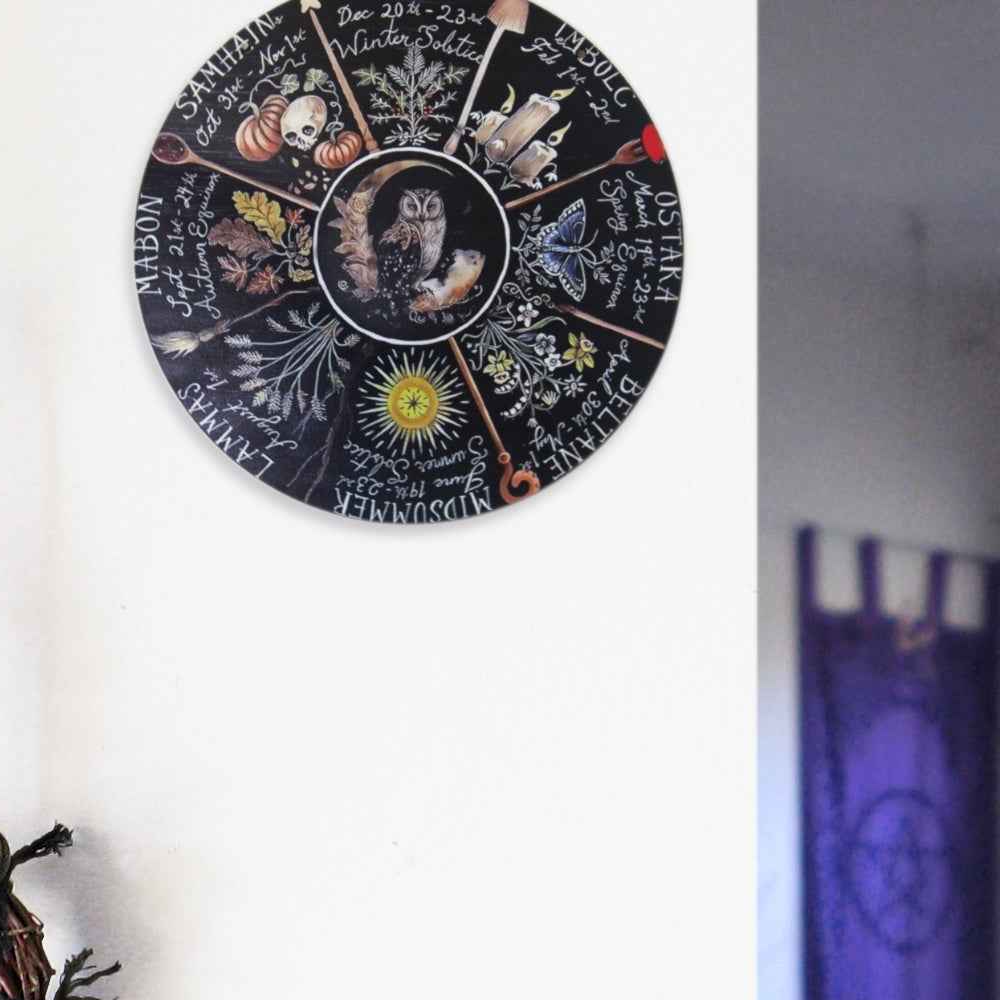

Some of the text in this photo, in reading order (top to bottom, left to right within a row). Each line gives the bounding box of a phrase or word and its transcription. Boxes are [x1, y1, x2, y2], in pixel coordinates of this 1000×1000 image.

[327, 17, 484, 65] Winter Solstice
[337, 4, 374, 27] Dec
[175, 12, 276, 120] SAMHAIN
[520, 37, 562, 65] Feb
[555, 23, 632, 108] IMBOLC
[196, 105, 222, 147] Oct
[259, 43, 286, 74] Nov
[625, 170, 656, 229] March
[134, 193, 164, 295] MABON
[187, 172, 222, 320] Autumn Equinox
[597, 178, 638, 309] Spring Equinox
[654, 191, 683, 303] OSTARA
[162, 266, 195, 318] Sept
[597, 338, 631, 396] April
[178, 382, 275, 479] LAMMAS
[222, 400, 298, 450] August
[543, 374, 645, 481] BELTANE
[343, 435, 488, 483] Summer Solstice
[434, 462, 486, 494] June
[333, 486, 493, 525] MIDSUMMER
